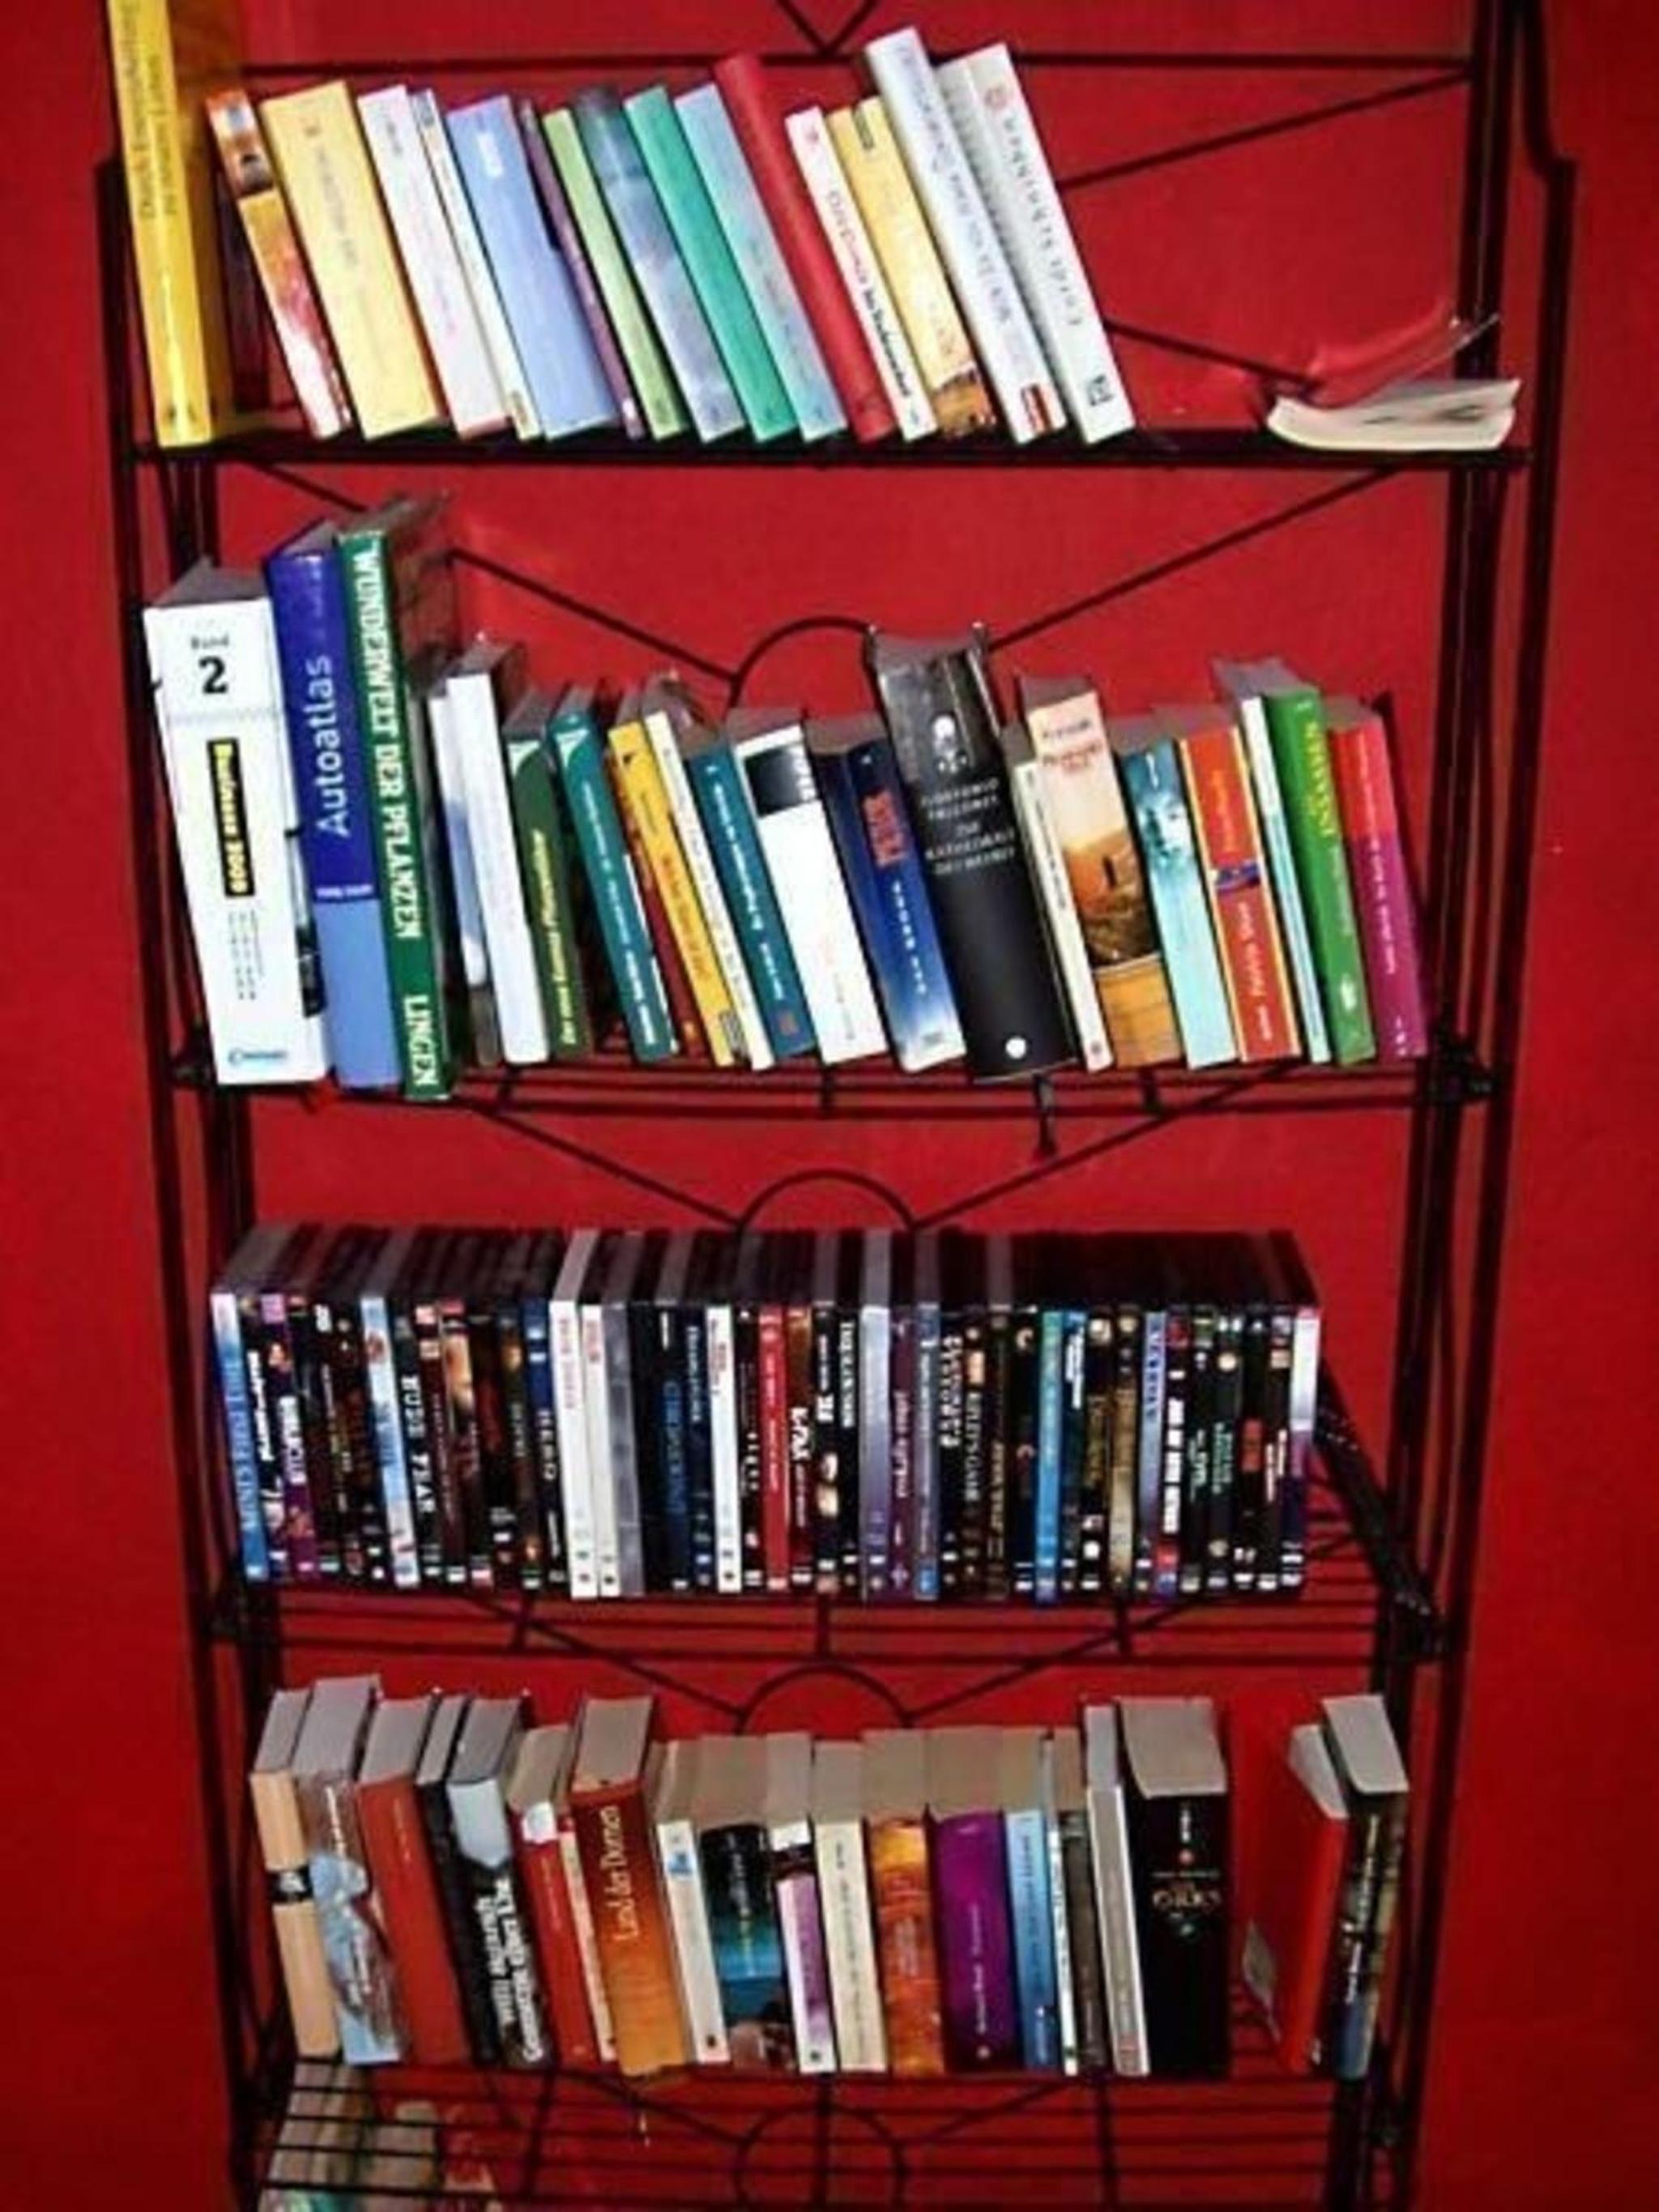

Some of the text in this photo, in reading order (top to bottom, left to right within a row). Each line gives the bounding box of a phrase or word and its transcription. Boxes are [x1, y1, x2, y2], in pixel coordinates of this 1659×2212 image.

[198, 655, 228, 694] 2
[304, 654, 350, 837] Autoatlas
[353, 539, 421, 939] WUNDERWELT DER PFLANZEN
[403, 994, 439, 1086] LINGEN
[605, 1898, 640, 1941] Land
